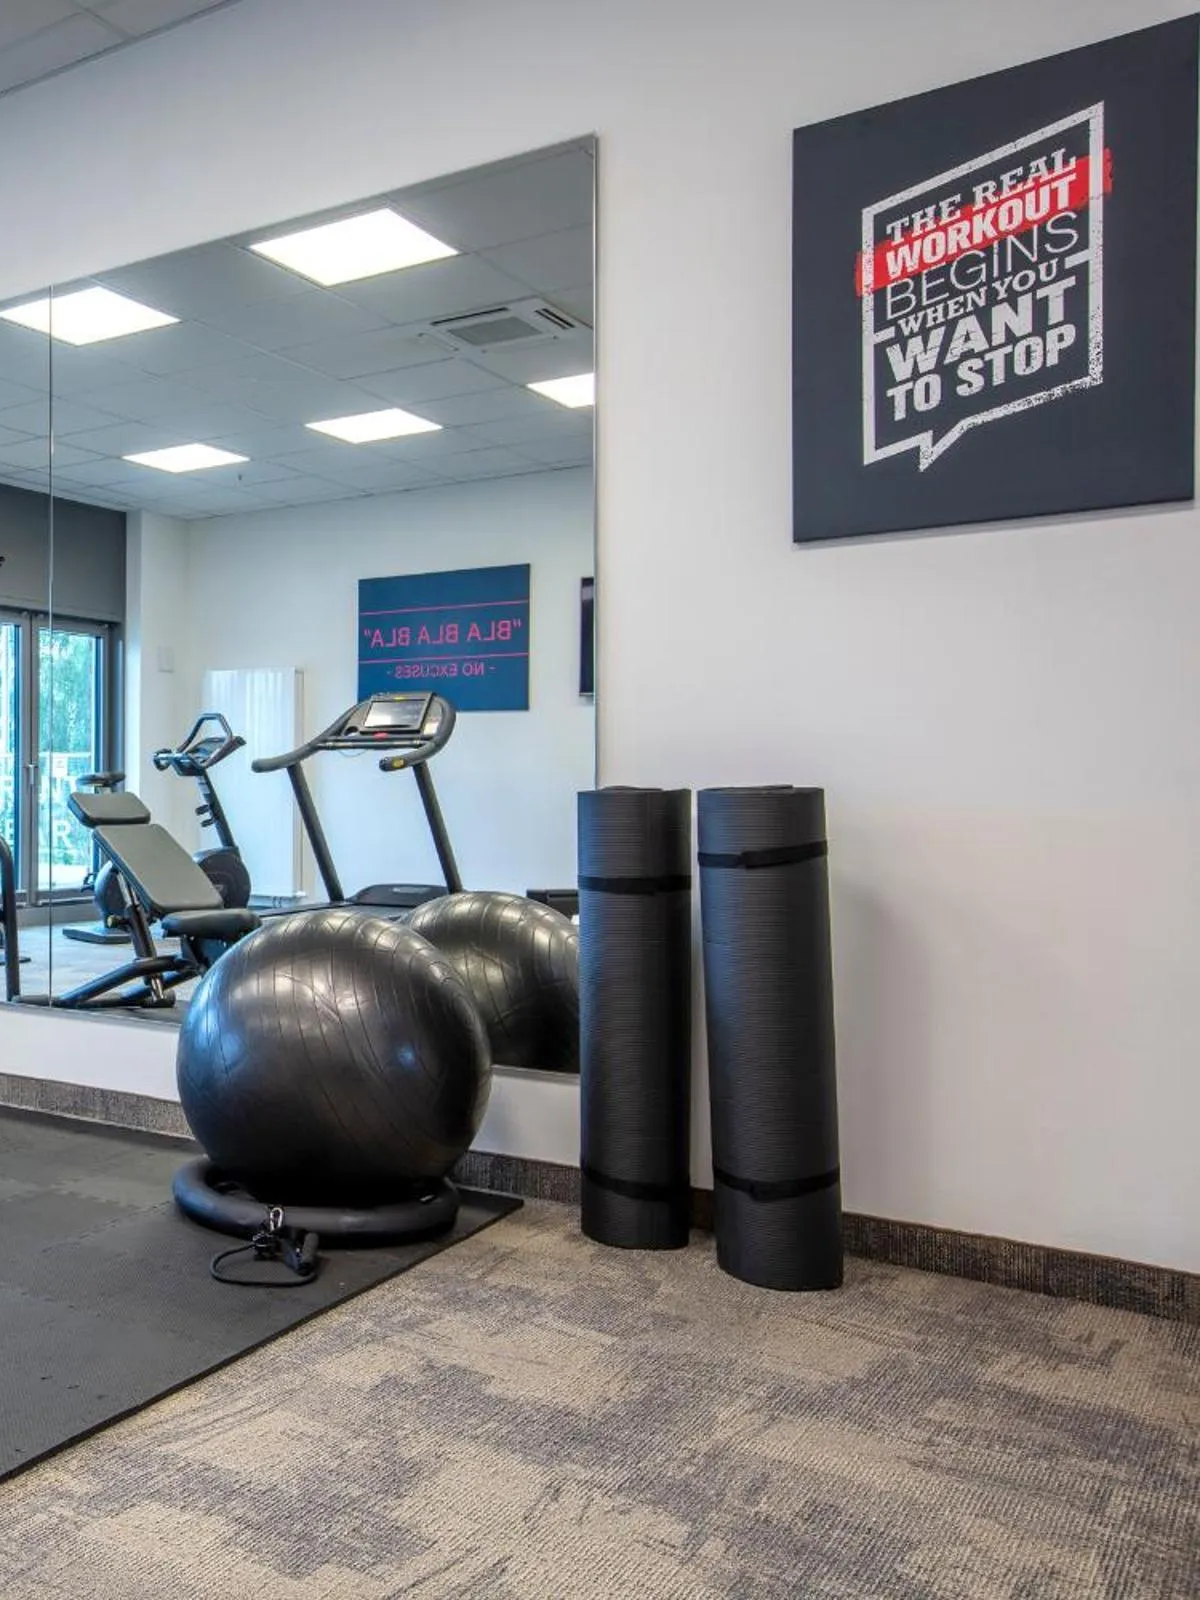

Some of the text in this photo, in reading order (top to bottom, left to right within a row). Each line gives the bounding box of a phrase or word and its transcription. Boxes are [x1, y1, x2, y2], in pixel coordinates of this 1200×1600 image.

[886, 148, 1077, 246] THE REAL
[886, 174, 1077, 279] WORKOUT
[887, 211, 1079, 320] BEGINS
[898, 258, 1060, 338] WHEN YOU
[886, 276, 1077, 382] WANT
[886, 323, 1077, 422] TO STOP
